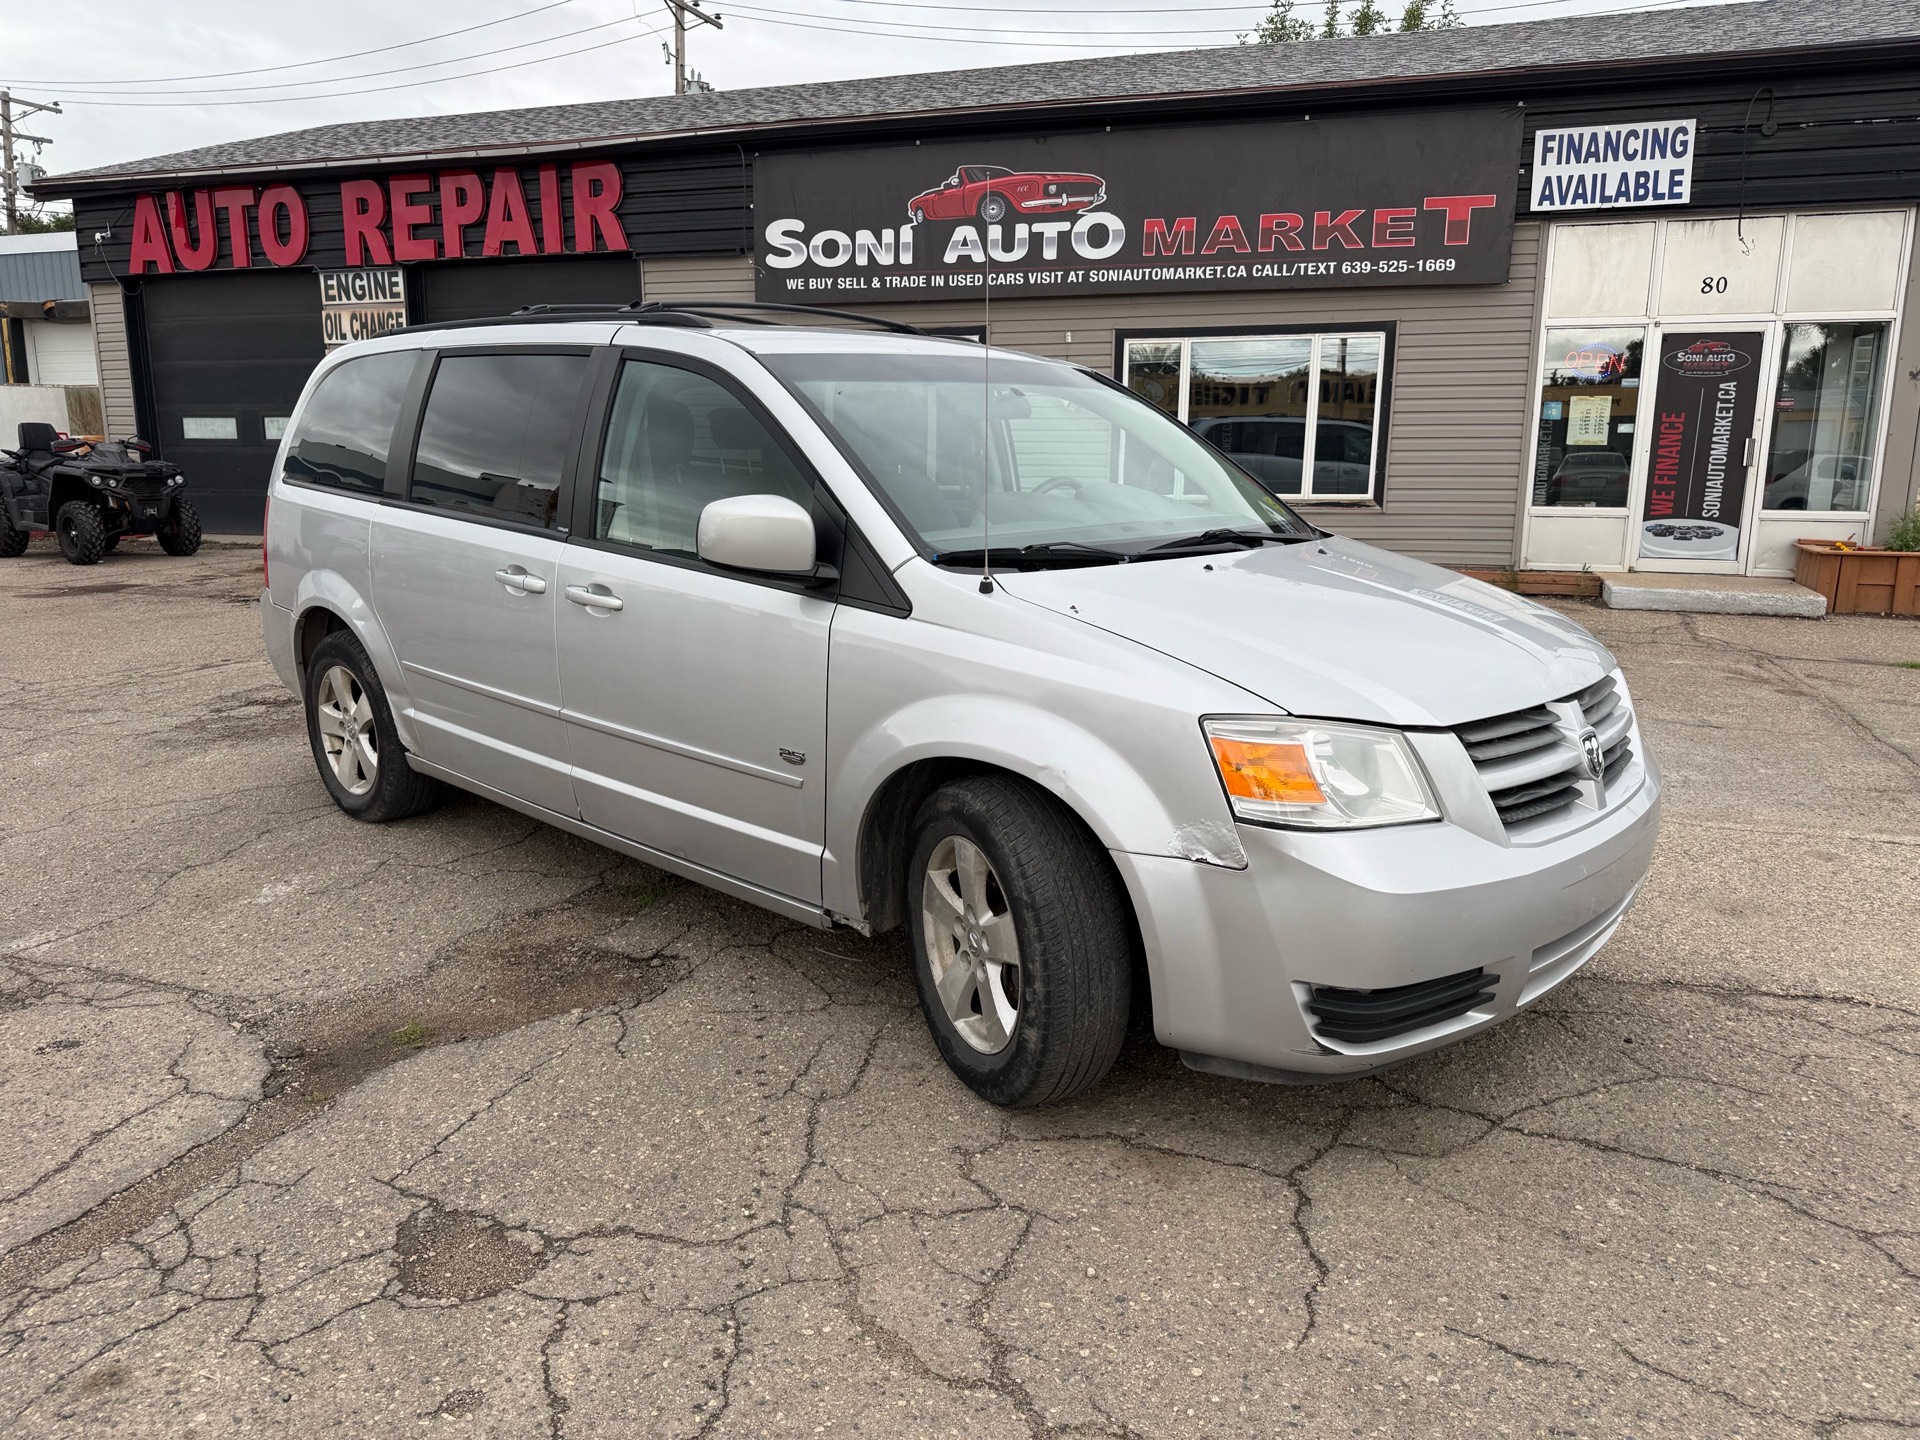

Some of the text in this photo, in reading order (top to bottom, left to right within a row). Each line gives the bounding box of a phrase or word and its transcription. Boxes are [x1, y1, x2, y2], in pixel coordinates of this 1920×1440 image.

[1540, 126, 1689, 166] FINANCING
[1537, 169, 1685, 206] AVAILABLE
[129, 160, 630, 274] AUTO REPAIR
[765, 194, 1497, 269] SONI AUTO MARKET
[323, 271, 401, 302] ENGINE
[786, 258, 1456, 290] WE BUY SELL & TRADE IN USED CARS VISIT AT SONIAUTOMARKET.CA CALL/TEXT 639-525-1669
[1700, 276, 1728, 294] 80
[324, 311, 404, 341] OIL CHANGE
[1565, 351, 1627, 374] OPEN
[1677, 352, 1736, 362] SONI AUTO
[1650, 412, 1686, 516] WE FINANCE
[1702, 381, 1738, 518] SONIAUTOMARKET.CA
